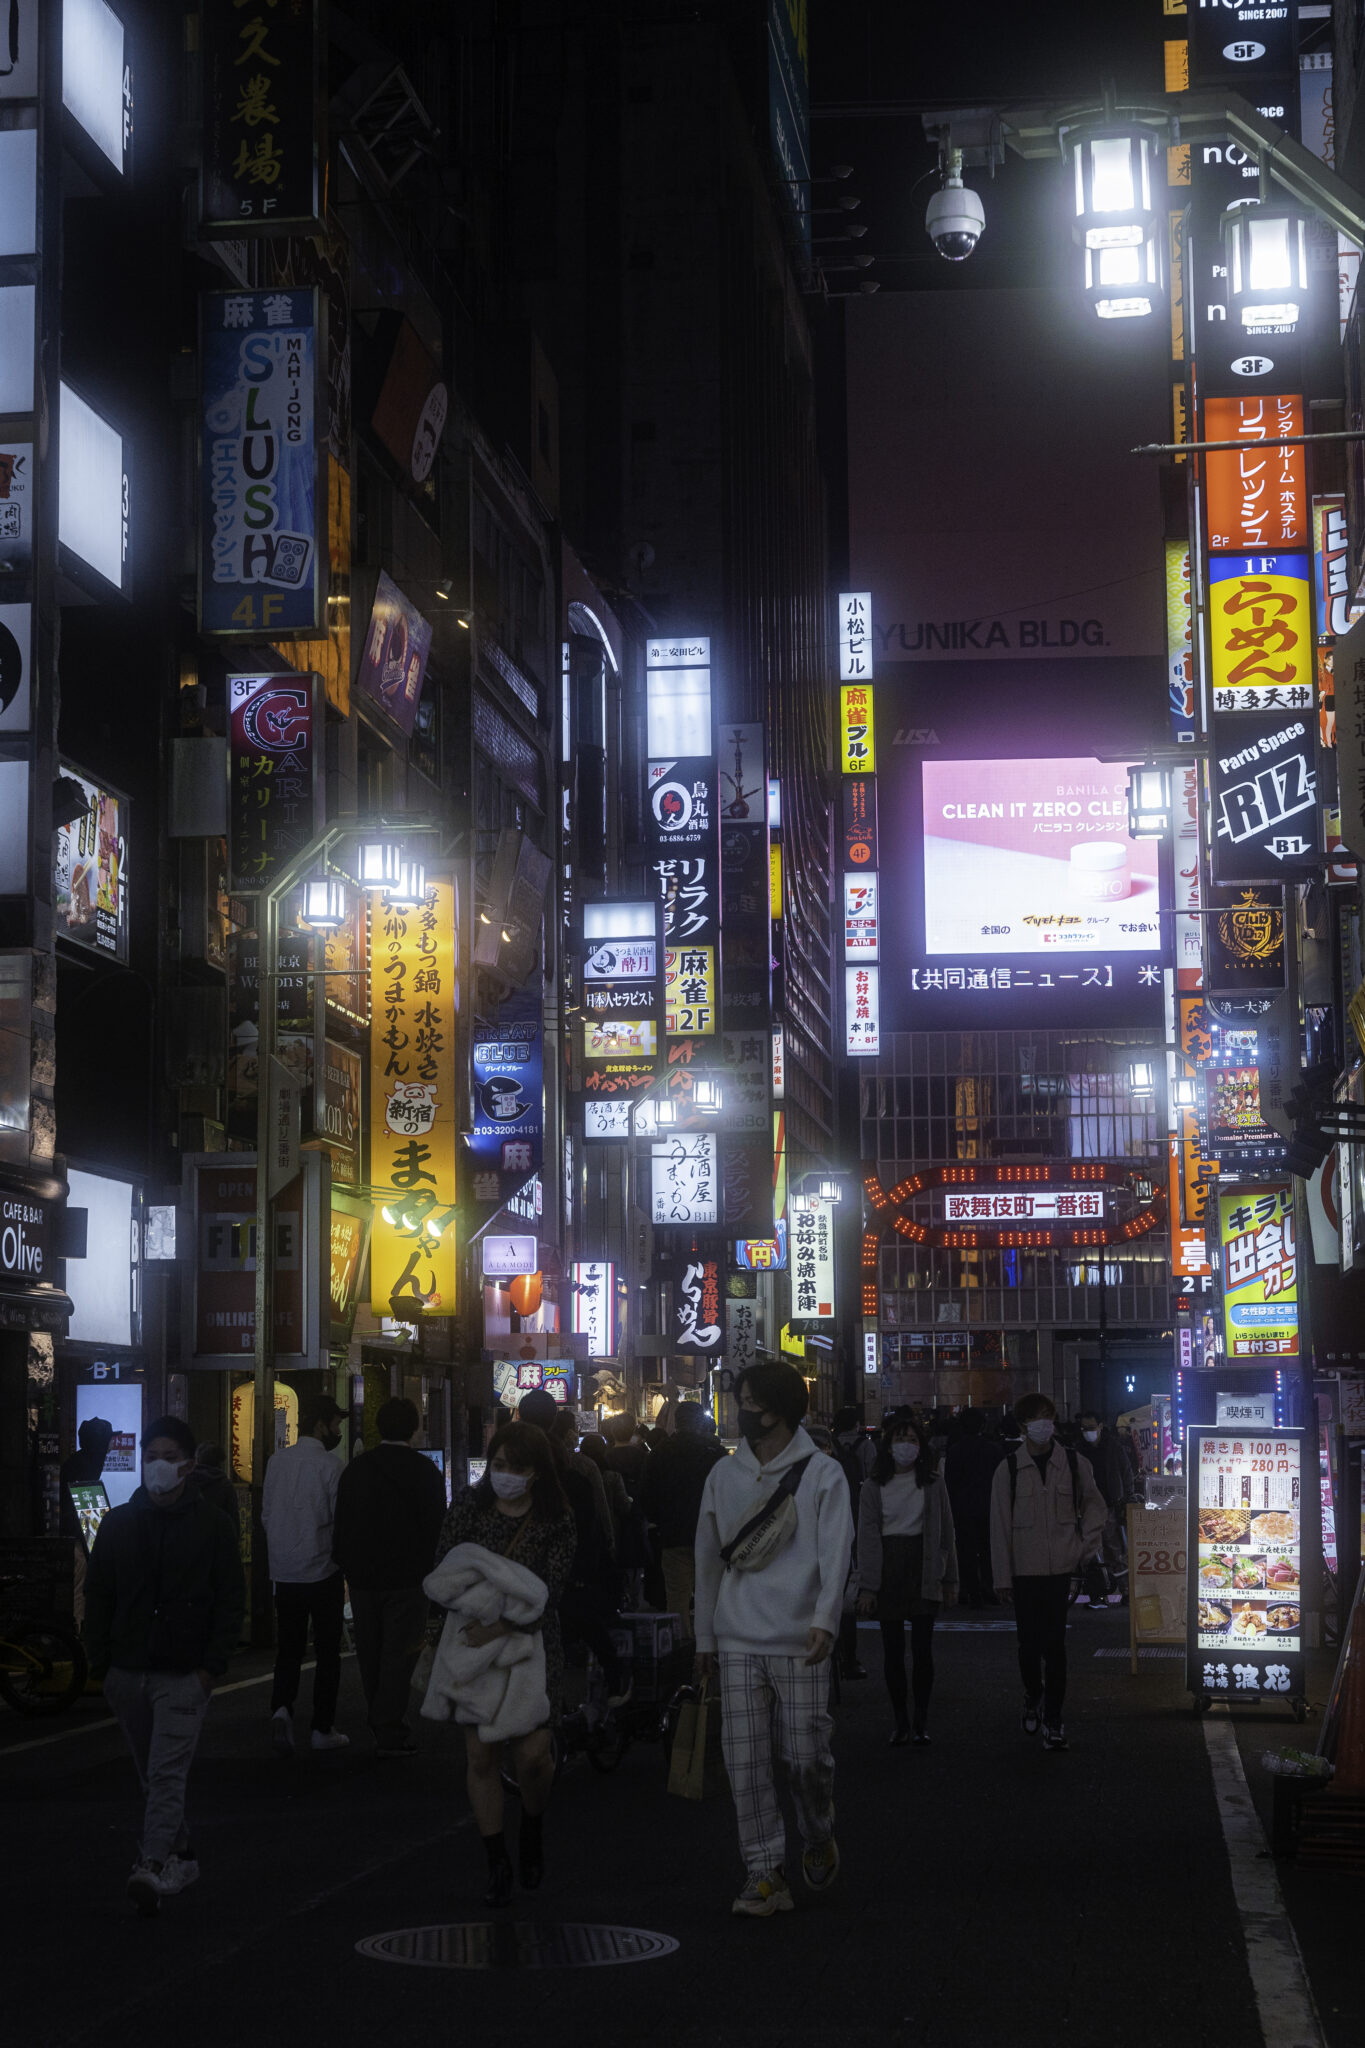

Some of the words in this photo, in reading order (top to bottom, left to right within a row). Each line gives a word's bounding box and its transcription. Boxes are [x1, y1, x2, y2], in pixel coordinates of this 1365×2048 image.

[1239, 10, 1265, 20] SINCE
[1265, 8, 1288, 19] 2007
[1234, 44, 1255, 58] 5F
[230, 0, 283, 185] 久農場
[239, 198, 277, 215] 5F
[222, 294, 293, 328] 麻雀
[1242, 360, 1262, 374] 3F
[287, 338, 301, 442] MAH-JONG
[242, 339, 275, 580] SLUSH
[215, 443, 238, 580] エスラッシュ
[1280, 491, 1297, 539] ホステル
[1212, 534, 1229, 548] 2F
[1244, 557, 1276, 574] 1F
[231, 594, 285, 627] 4F
[846, 598, 866, 675] 小松ビル
[874, 622, 1011, 650] YUNIKA
[1019, 619, 1112, 647] BLDG.
[651, 646, 706, 658] 第二安田ビル
[234, 680, 258, 696] 3F
[1215, 687, 1310, 709] 博多天神
[846, 687, 869, 758] 麻雀ブル
[1218, 744, 1260, 774] Party
[1258, 720, 1306, 755] Space
[652, 767, 666, 778] 4F
[849, 759, 866, 772] 6F
[1056, 785, 1109, 796] BANILA
[1217, 754, 1316, 843] RIZ
[252, 755, 275, 873] カリーナ
[942, 804, 1004, 819] CLEAN
[1010, 803, 1027, 818] IT
[1032, 801, 1082, 817] ZERO
[1033, 823, 1072, 833] バニラコ
[853, 849, 867, 859] 4F
[1276, 839, 1300, 853] B1
[680, 858, 709, 938] リラク
[980, 924, 1011, 935] 全国の
[1023, 914, 1082, 927] マツモトキヨシ
[1086, 916, 1110, 924] グループ
[412, 886, 441, 996] 博多もつ鍋
[852, 939, 871, 947] ATM
[621, 956, 650, 972] 酔月
[680, 949, 709, 1006] 麻雀
[911, 965, 1114, 990] 【共同通信ニュース】
[1138, 965, 1161, 986] 米
[586, 990, 654, 1009] 日本人セラピスト
[856, 970, 870, 1019] お好み焼
[680, 1007, 711, 1031] 2F
[850, 1021, 876, 1034] 本陣
[413, 1001, 444, 1081] 水炊き
[475, 1042, 531, 1064] BLUE
[773, 1035, 783, 1086] リーチ麻雀
[484, 1064, 524, 1073] グレイトブルー
[388, 1099, 433, 1122] 新宿
[587, 1102, 630, 1115] 居酒屋
[278, 1088, 291, 1169] 劇場通り一番街
[403, 1121, 419, 1134] の
[481, 1125, 539, 1137] 03-3200-4181
[692, 1133, 713, 1204] 居酒屋
[3, 1201, 22, 1221] CAFE
[23, 1205, 30, 1222] &
[30, 1208, 44, 1225] BAR
[694, 1211, 716, 1222] B1F
[948, 1194, 1100, 1218] 歌舞伎町一番街
[2, 1223, 44, 1274] Olive
[751, 1246, 773, 1269] 円
[796, 1213, 817, 1312] お好み焼本陣
[702, 1260, 719, 1325] 東京豚骨
[1182, 1275, 1213, 1293] 2F
[1240, 1305, 1298, 1317] 女性は全て無
[866, 1335, 875, 1372] 劇場通り
[1182, 1330, 1191, 1368] 劇場通り
[1236, 1341, 1291, 1354] 受付3F
[94, 1361, 120, 1380] B1
[544, 1366, 568, 1377] フリー
[1226, 1406, 1265, 1419] 喫煙可
[1203, 1441, 1244, 1455] 焼き鳥
[737, 1514, 778, 1561] BURBERRY
[1137, 1551, 1186, 1572] 280
